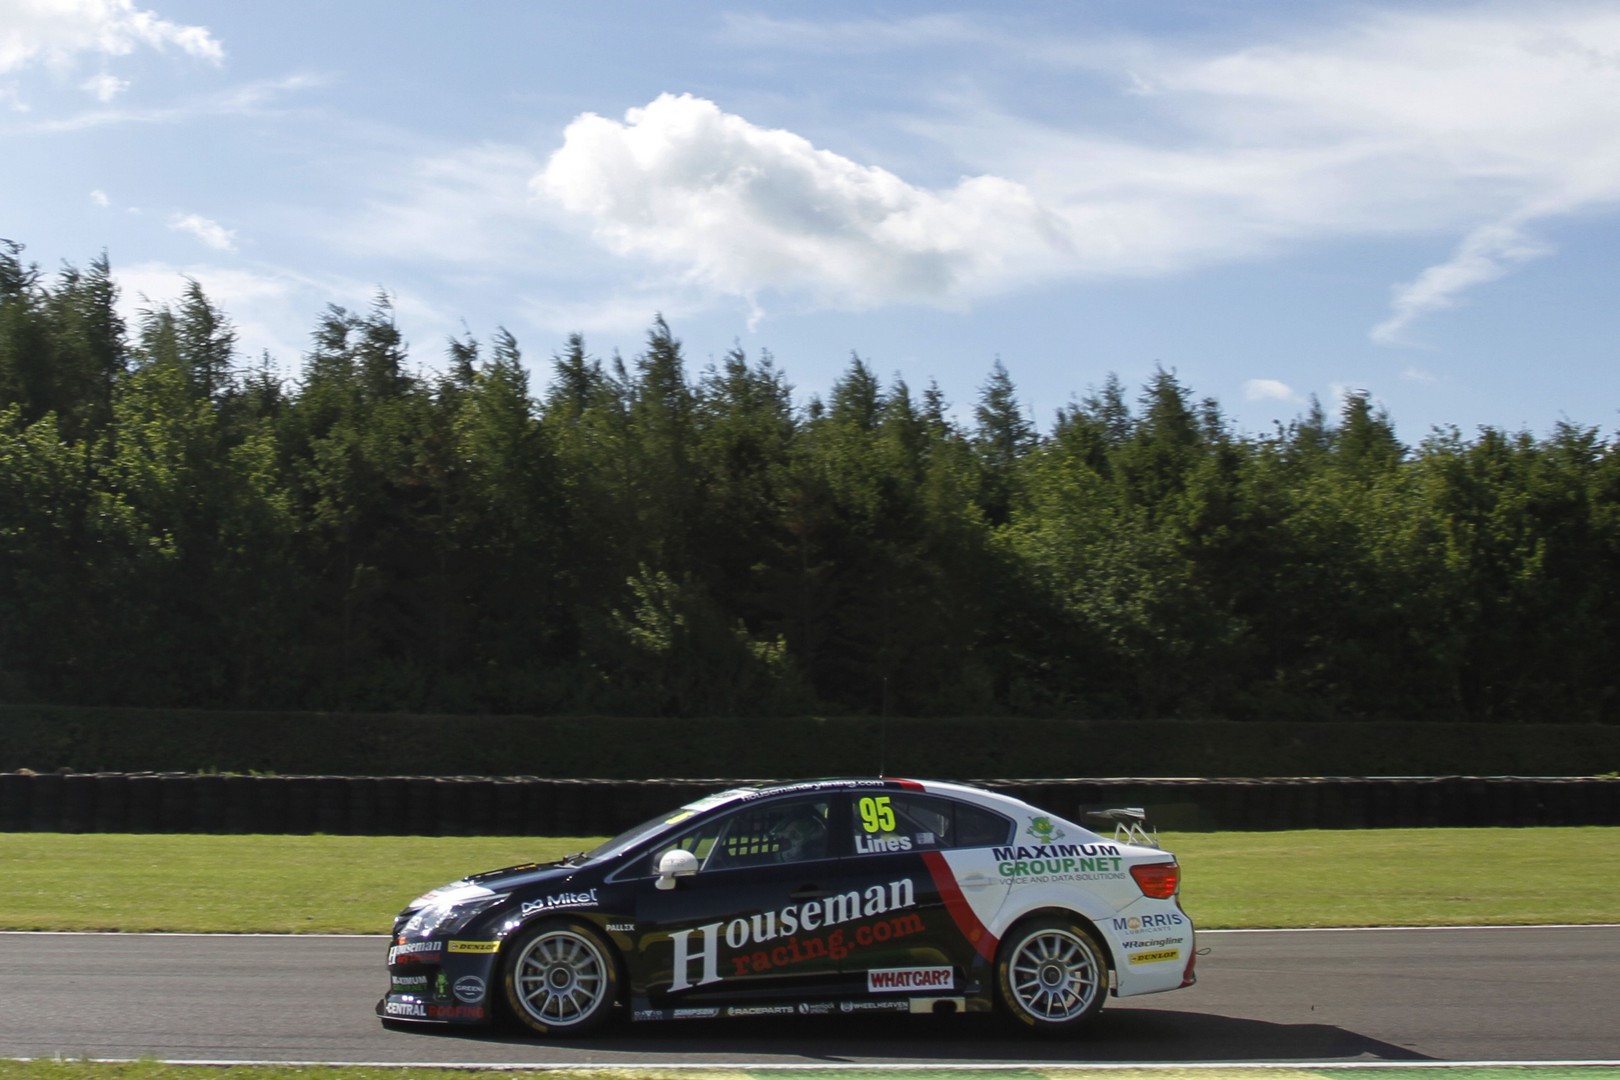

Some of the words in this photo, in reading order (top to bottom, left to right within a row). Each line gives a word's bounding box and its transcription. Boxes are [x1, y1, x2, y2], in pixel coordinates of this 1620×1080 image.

[858, 796, 896, 833] 95
[855, 834, 912, 854] Lines
[992, 844, 1120, 861] MAXIMUM
[998, 857, 1122, 877] GROUP.NET
[1000, 876, 1028, 886] VOICE
[1030, 875, 1049, 884] AND
[1052, 873, 1075, 882] DATA
[1076, 872, 1126, 881] SOLUTIONS
[547, 888, 598, 906] Mitel
[1113, 914, 1183, 930] MORRIS
[1125, 926, 1171, 935] LUBRICANTS
[667, 878, 916, 993] Houseman
[388, 941, 442, 965] Houseman
[731, 913, 926, 976] racing.com
[1137, 951, 1176, 961] DUNLOP
[386, 1003, 427, 1016] CENTRAL
[735, 1006, 794, 1015] RACEPARTS
